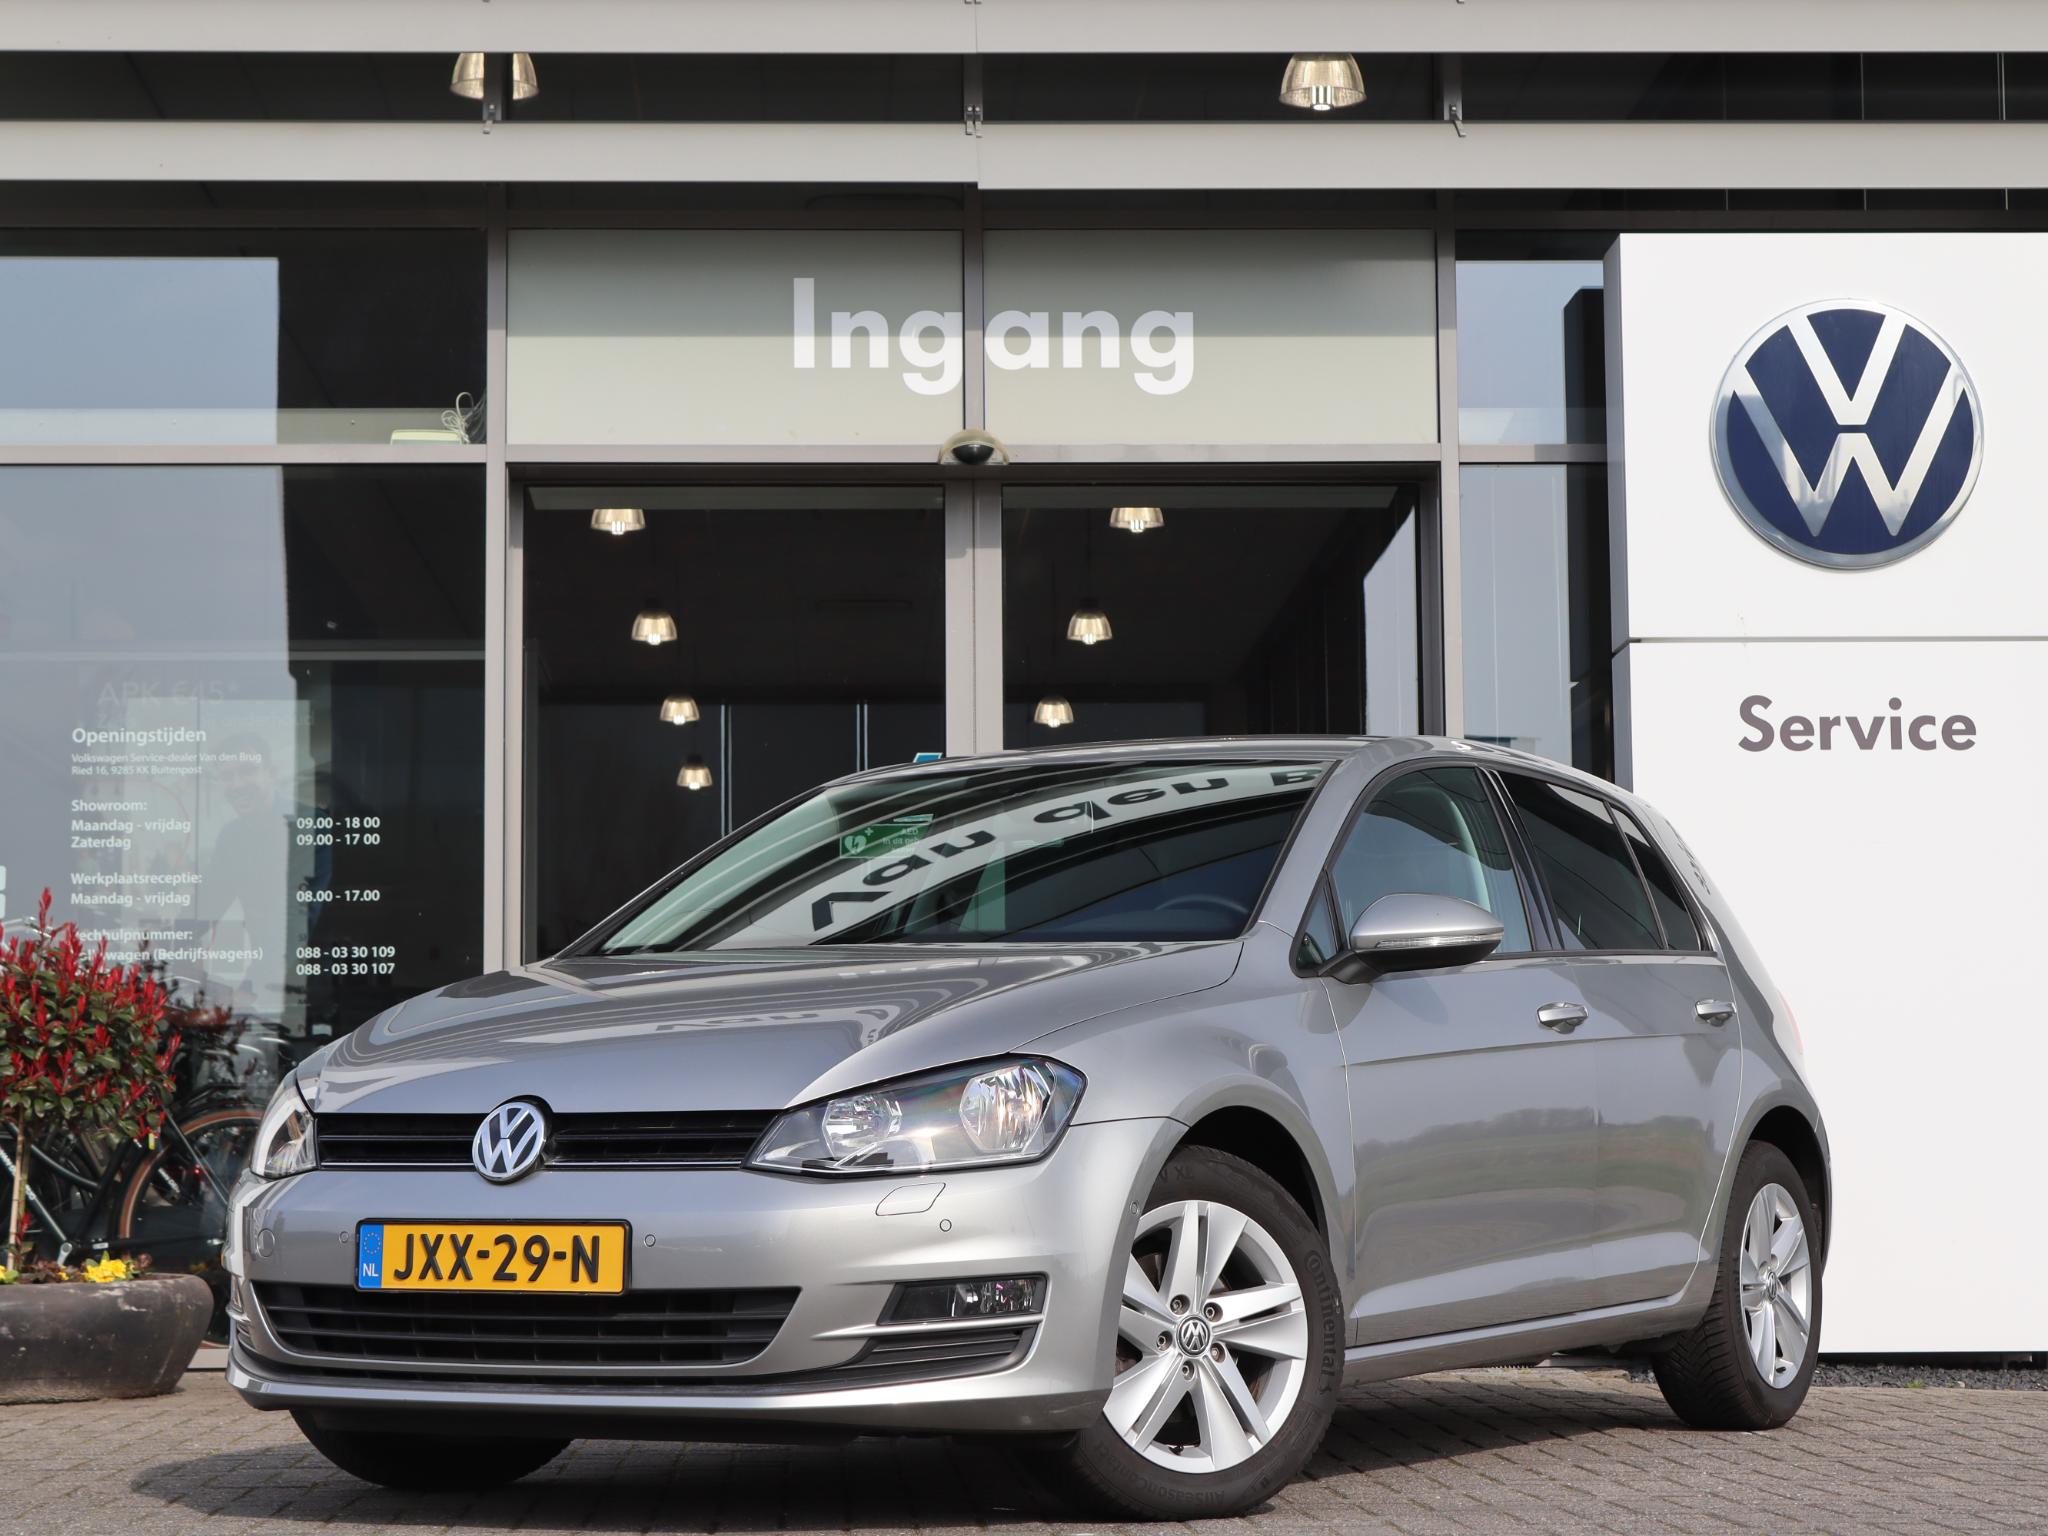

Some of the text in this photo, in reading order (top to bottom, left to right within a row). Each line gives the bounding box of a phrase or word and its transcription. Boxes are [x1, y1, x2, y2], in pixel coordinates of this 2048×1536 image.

[793, 277, 1194, 395] Ingang
[1738, 695, 1977, 752] Service
[71, 727, 207, 746] Openingstijden
[71, 752, 128, 765] Volkswagen
[199, 752, 216, 762] Van
[218, 751, 238, 762] den
[239, 751, 262, 764] Brug
[71, 765, 92, 775] Ried
[151, 764, 203, 777] Buitenpost
[71, 799, 148, 811] Showroom:
[71, 819, 133, 834] Maandag
[144, 818, 191, 833] vrijdag
[296, 817, 333, 829] 09.00
[71, 836, 132, 850] Zaterdag
[296, 834, 333, 846] 09.00
[70, 871, 203, 887] Werkplaatsreceptie:
[70, 892, 133, 907] Maandag
[144, 891, 191, 906] vrijdag
[296, 890, 333, 902] 08.00
[344, 890, 381, 902] 17.00
[77, 928, 193, 943] echhulpnummer:
[153, 948, 264, 963] (Bedrijfswagens)
[296, 947, 321, 958] 088
[331, 946, 348, 958] 03
[351, 946, 368, 958] 30
[371, 946, 396, 958] 109
[296, 963, 321, 975] 088
[331, 963, 348, 975] 03
[351, 963, 368, 975] 30
[371, 963, 396, 975] 107
[394, 1233, 600, 1284] JXX-29-N
[362, 1262, 379, 1278] NL
